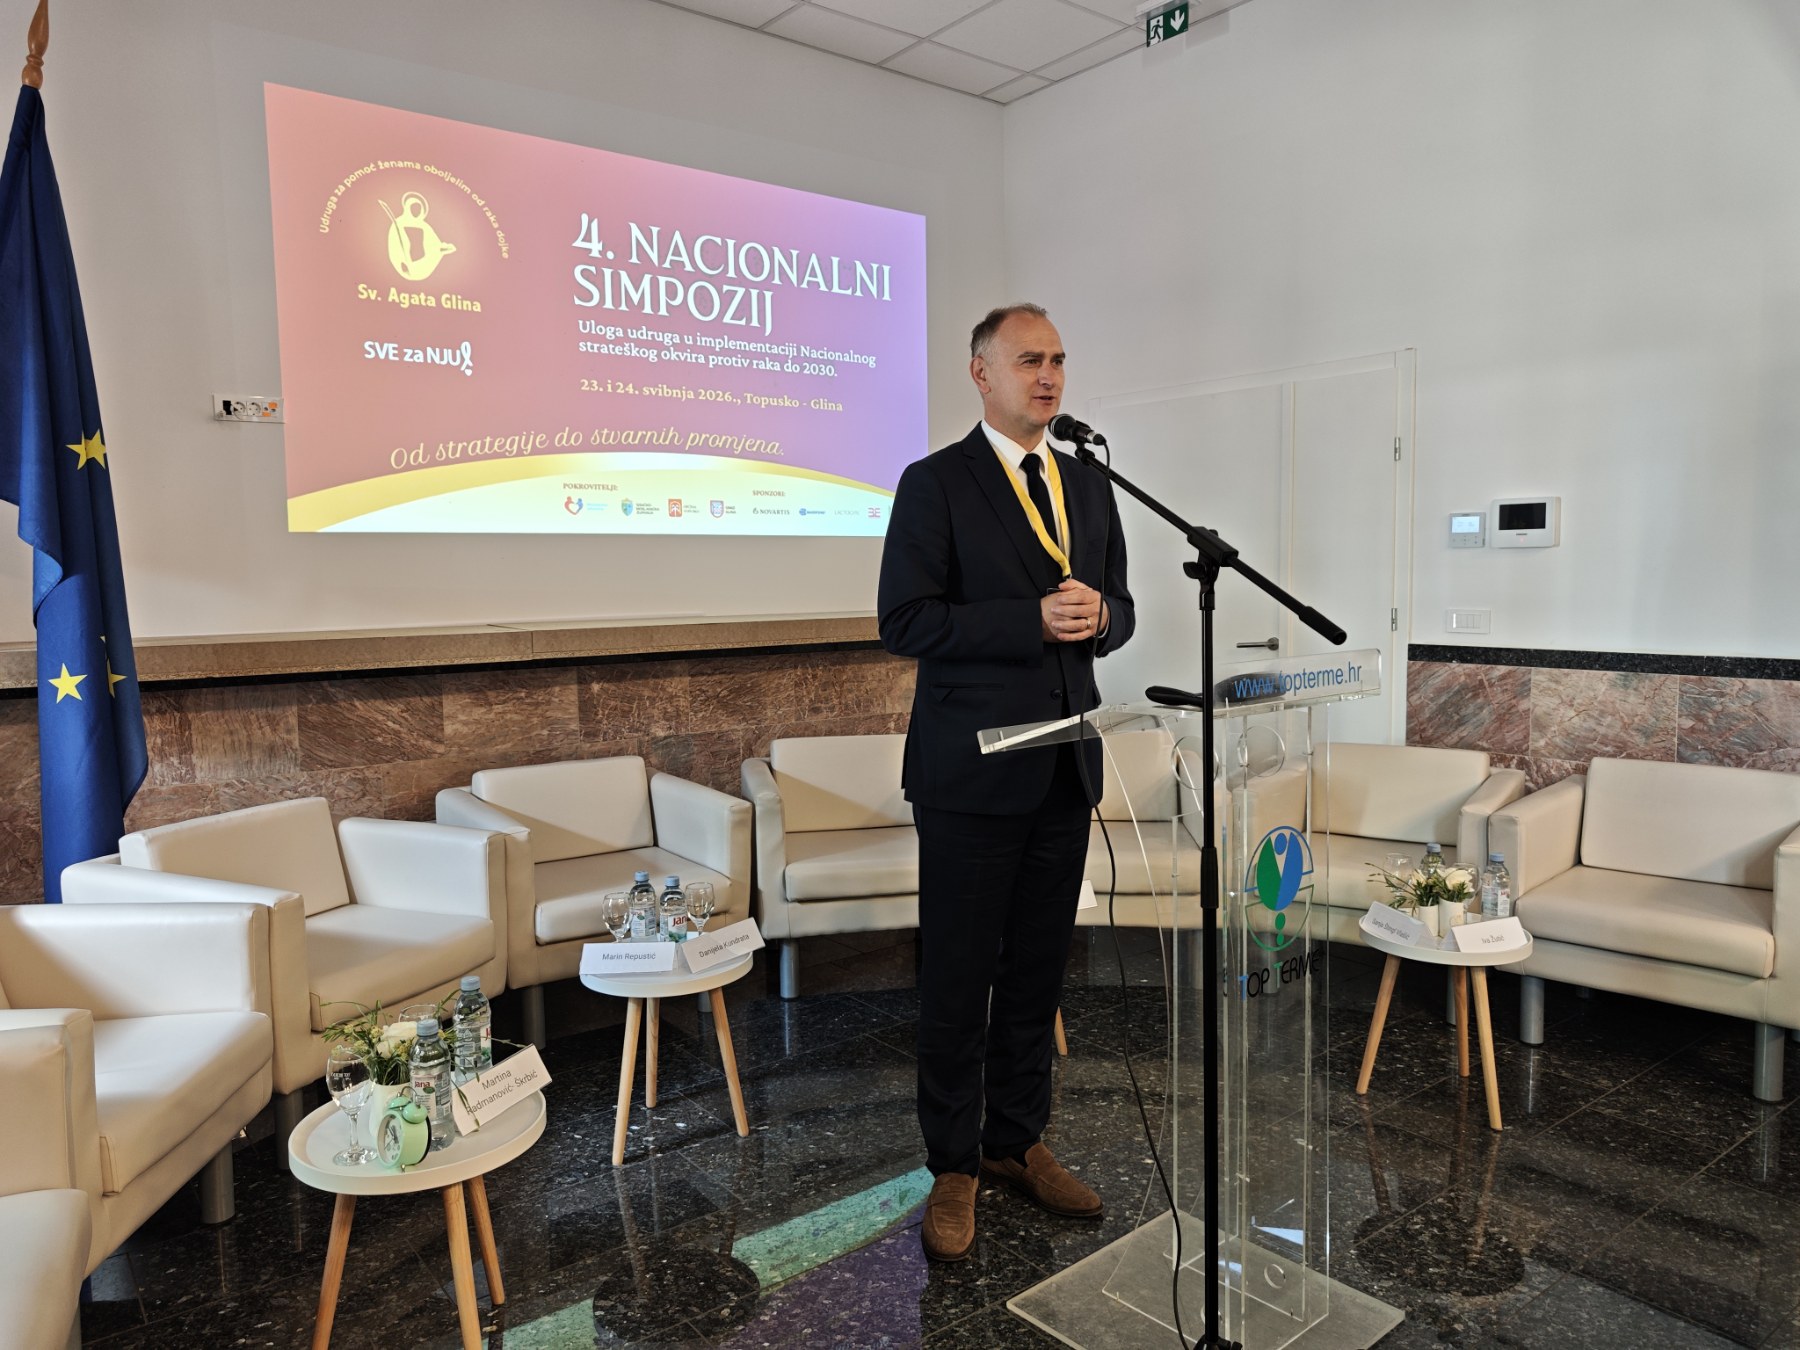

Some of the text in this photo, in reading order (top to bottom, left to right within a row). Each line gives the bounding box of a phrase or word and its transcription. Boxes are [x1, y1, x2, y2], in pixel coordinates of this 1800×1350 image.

[320, 196, 338, 233] Udruga
[334, 184, 346, 196] za
[377, 160, 421, 170] ženama
[424, 165, 471, 194] oboljelim
[471, 193, 485, 207] od
[483, 207, 499, 228] raka
[496, 230, 509, 259] dojke
[572, 212, 892, 301] 4. NACIONALNI
[358, 284, 482, 312] Sv. Agata Glina
[573, 264, 774, 337] SIMPOZIJ
[363, 341, 399, 360] SVE
[403, 348, 424, 363] za
[578, 319, 876, 368] Uloga udruga u implementaciji Nacionalnog
[579, 341, 838, 377] strateškog okvira protiv raka do 2030.
[580, 379, 603, 392] 23.
[607, 380, 613, 392] i
[615, 382, 639, 394] 24.
[642, 384, 695, 401] svibnja
[744, 393, 800, 408] Topusko
[810, 398, 843, 411] Glina
[390, 427, 785, 469] Od strategije do stvarnih promjena.
[1234, 661, 1362, 698] www.topterme.hr
[602, 952, 656, 961] Marin Repustić
[699, 934, 750, 958] Danijela Kundrata
[1238, 949, 1319, 1000] TOP TERME
[482, 1069, 512, 1091] Martina
[514, 1069, 538, 1088] Škrbić
